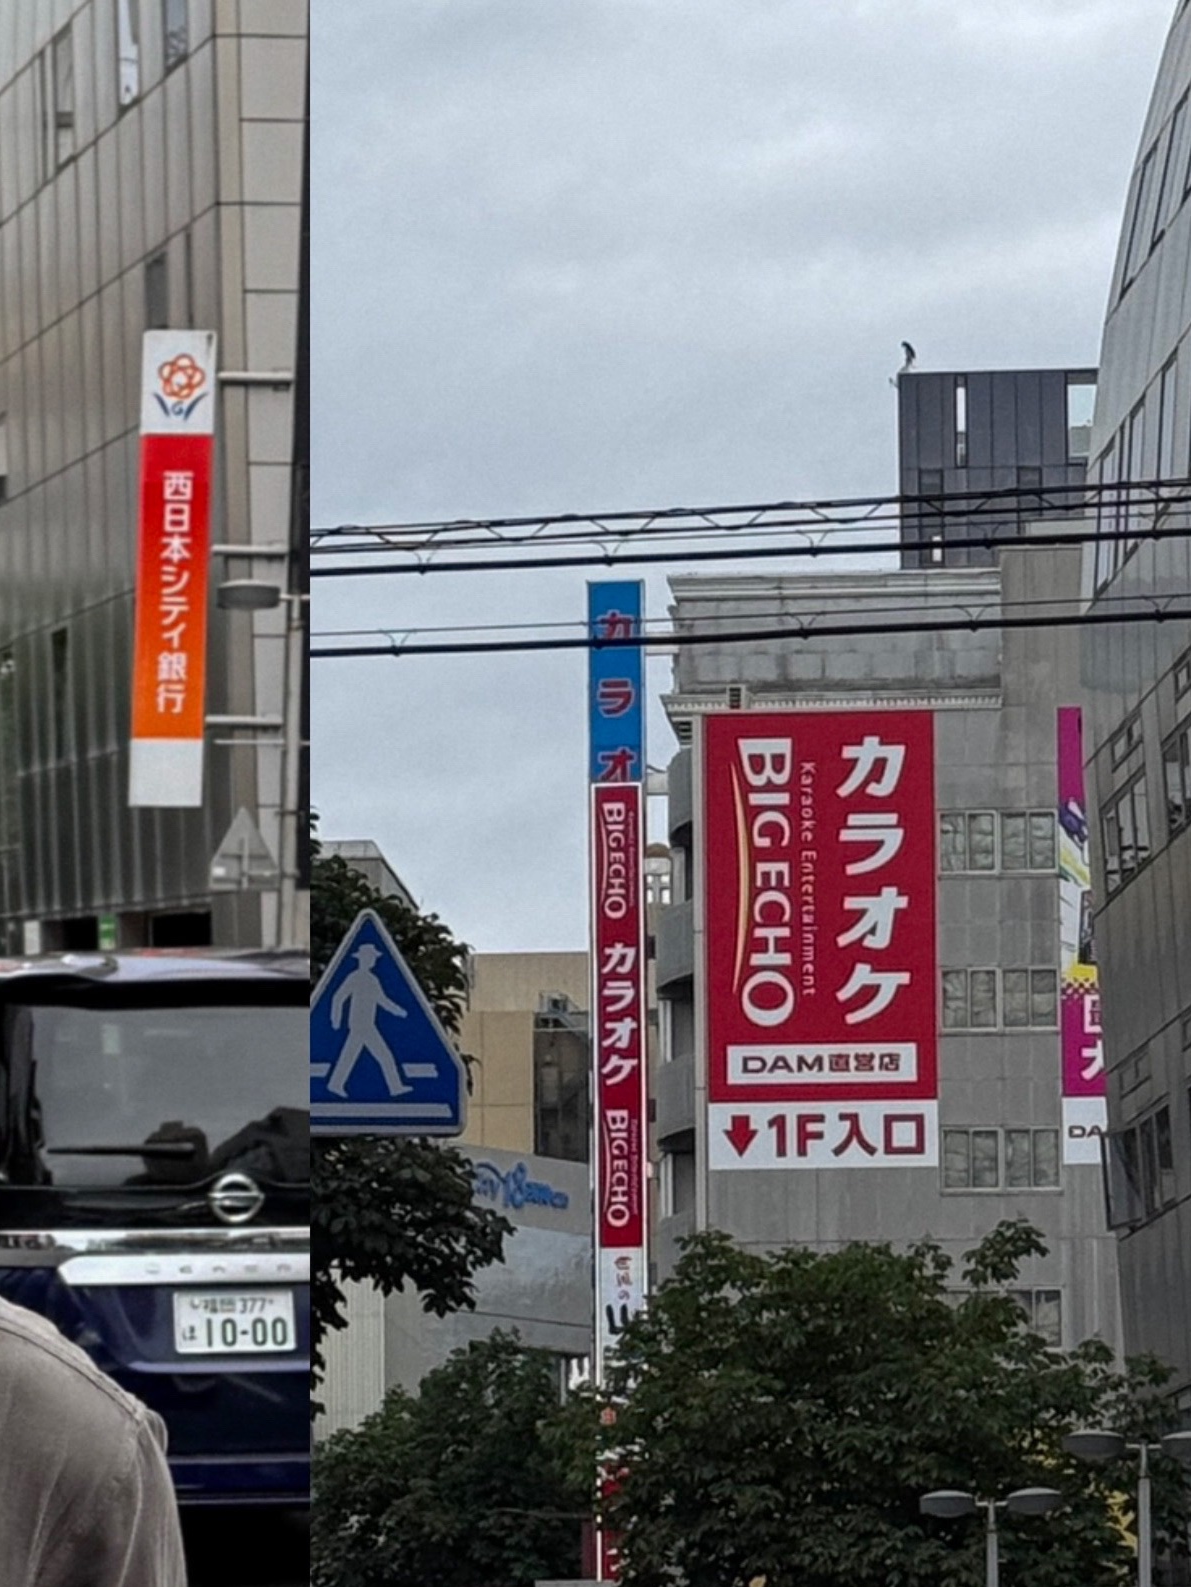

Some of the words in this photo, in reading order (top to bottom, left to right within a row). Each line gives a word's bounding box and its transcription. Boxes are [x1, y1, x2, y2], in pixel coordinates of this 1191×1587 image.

[156, 470, 194, 714] 西日本シティ銀行
[602, 802, 626, 847] BIG
[738, 737, 793, 848] BIG
[800, 762, 817, 841] Karaoke
[604, 851, 627, 919] ECHO
[835, 736, 911, 1025] カラオケ
[741, 861, 796, 1027] ECHO
[799, 850, 818, 996] Entertainment
[601, 942, 639, 1086] カラオケ
[741, 1052, 901, 1074] DAM直営店
[605, 1109, 629, 1155] BIG
[767, 1112, 926, 1158] 1F入口
[607, 1159, 630, 1228] ECHO
[206, 1316, 288, 1348] 10-00
[240, 1297, 267, 1314] 377
